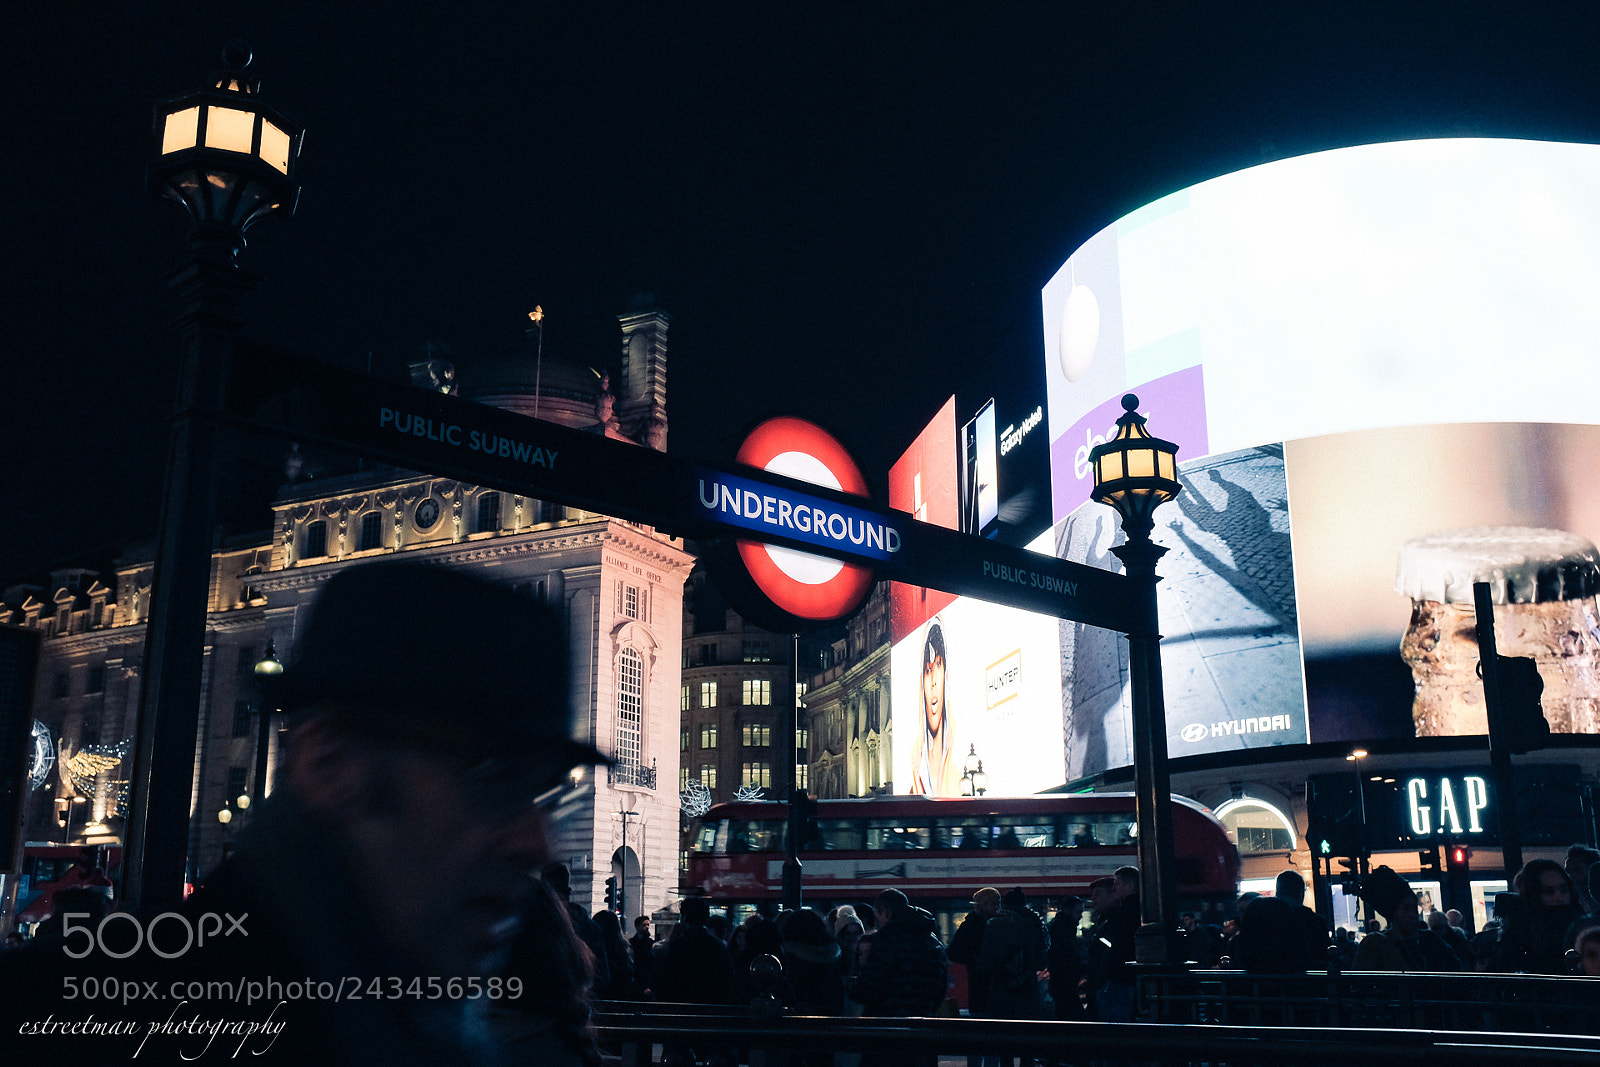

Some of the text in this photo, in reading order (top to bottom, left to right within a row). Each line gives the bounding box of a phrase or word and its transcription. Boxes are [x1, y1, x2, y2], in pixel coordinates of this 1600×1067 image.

[380, 407, 560, 470] PUBLIC SUBWAY
[1001, 426, 1023, 456] Galaxy
[1022, 405, 1043, 437] Note8
[699, 478, 902, 554] UNDERGROUND
[605, 555, 662, 584] ALLIANCE LIFE OFFICE
[983, 560, 1078, 597] PUBLIC SUBWAY
[1211, 713, 1291, 738] HYUNDAI
[1408, 776, 1488, 835] GAP
